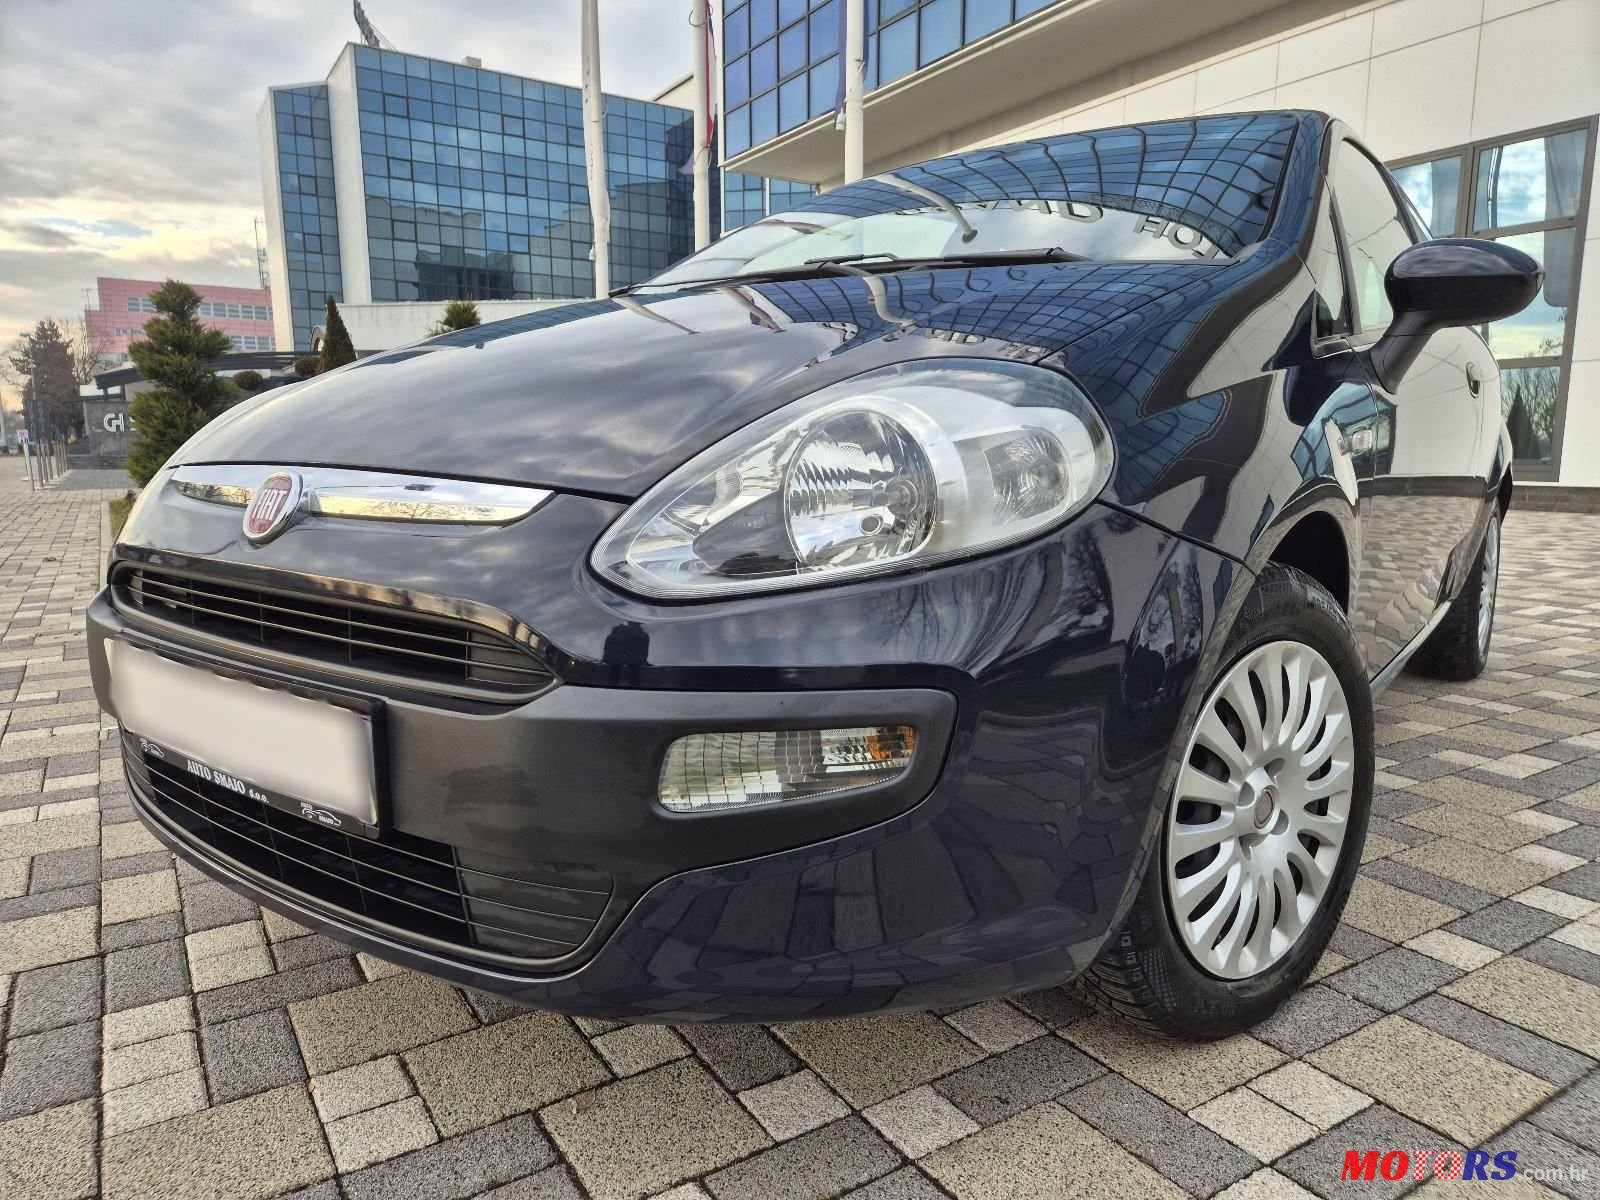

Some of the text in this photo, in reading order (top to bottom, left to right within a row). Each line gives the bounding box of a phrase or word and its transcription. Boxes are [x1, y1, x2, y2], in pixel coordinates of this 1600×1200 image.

[251, 488, 289, 521] FIAT
[187, 759, 212, 781] AUTO
[213, 770, 246, 795] SMAJO
